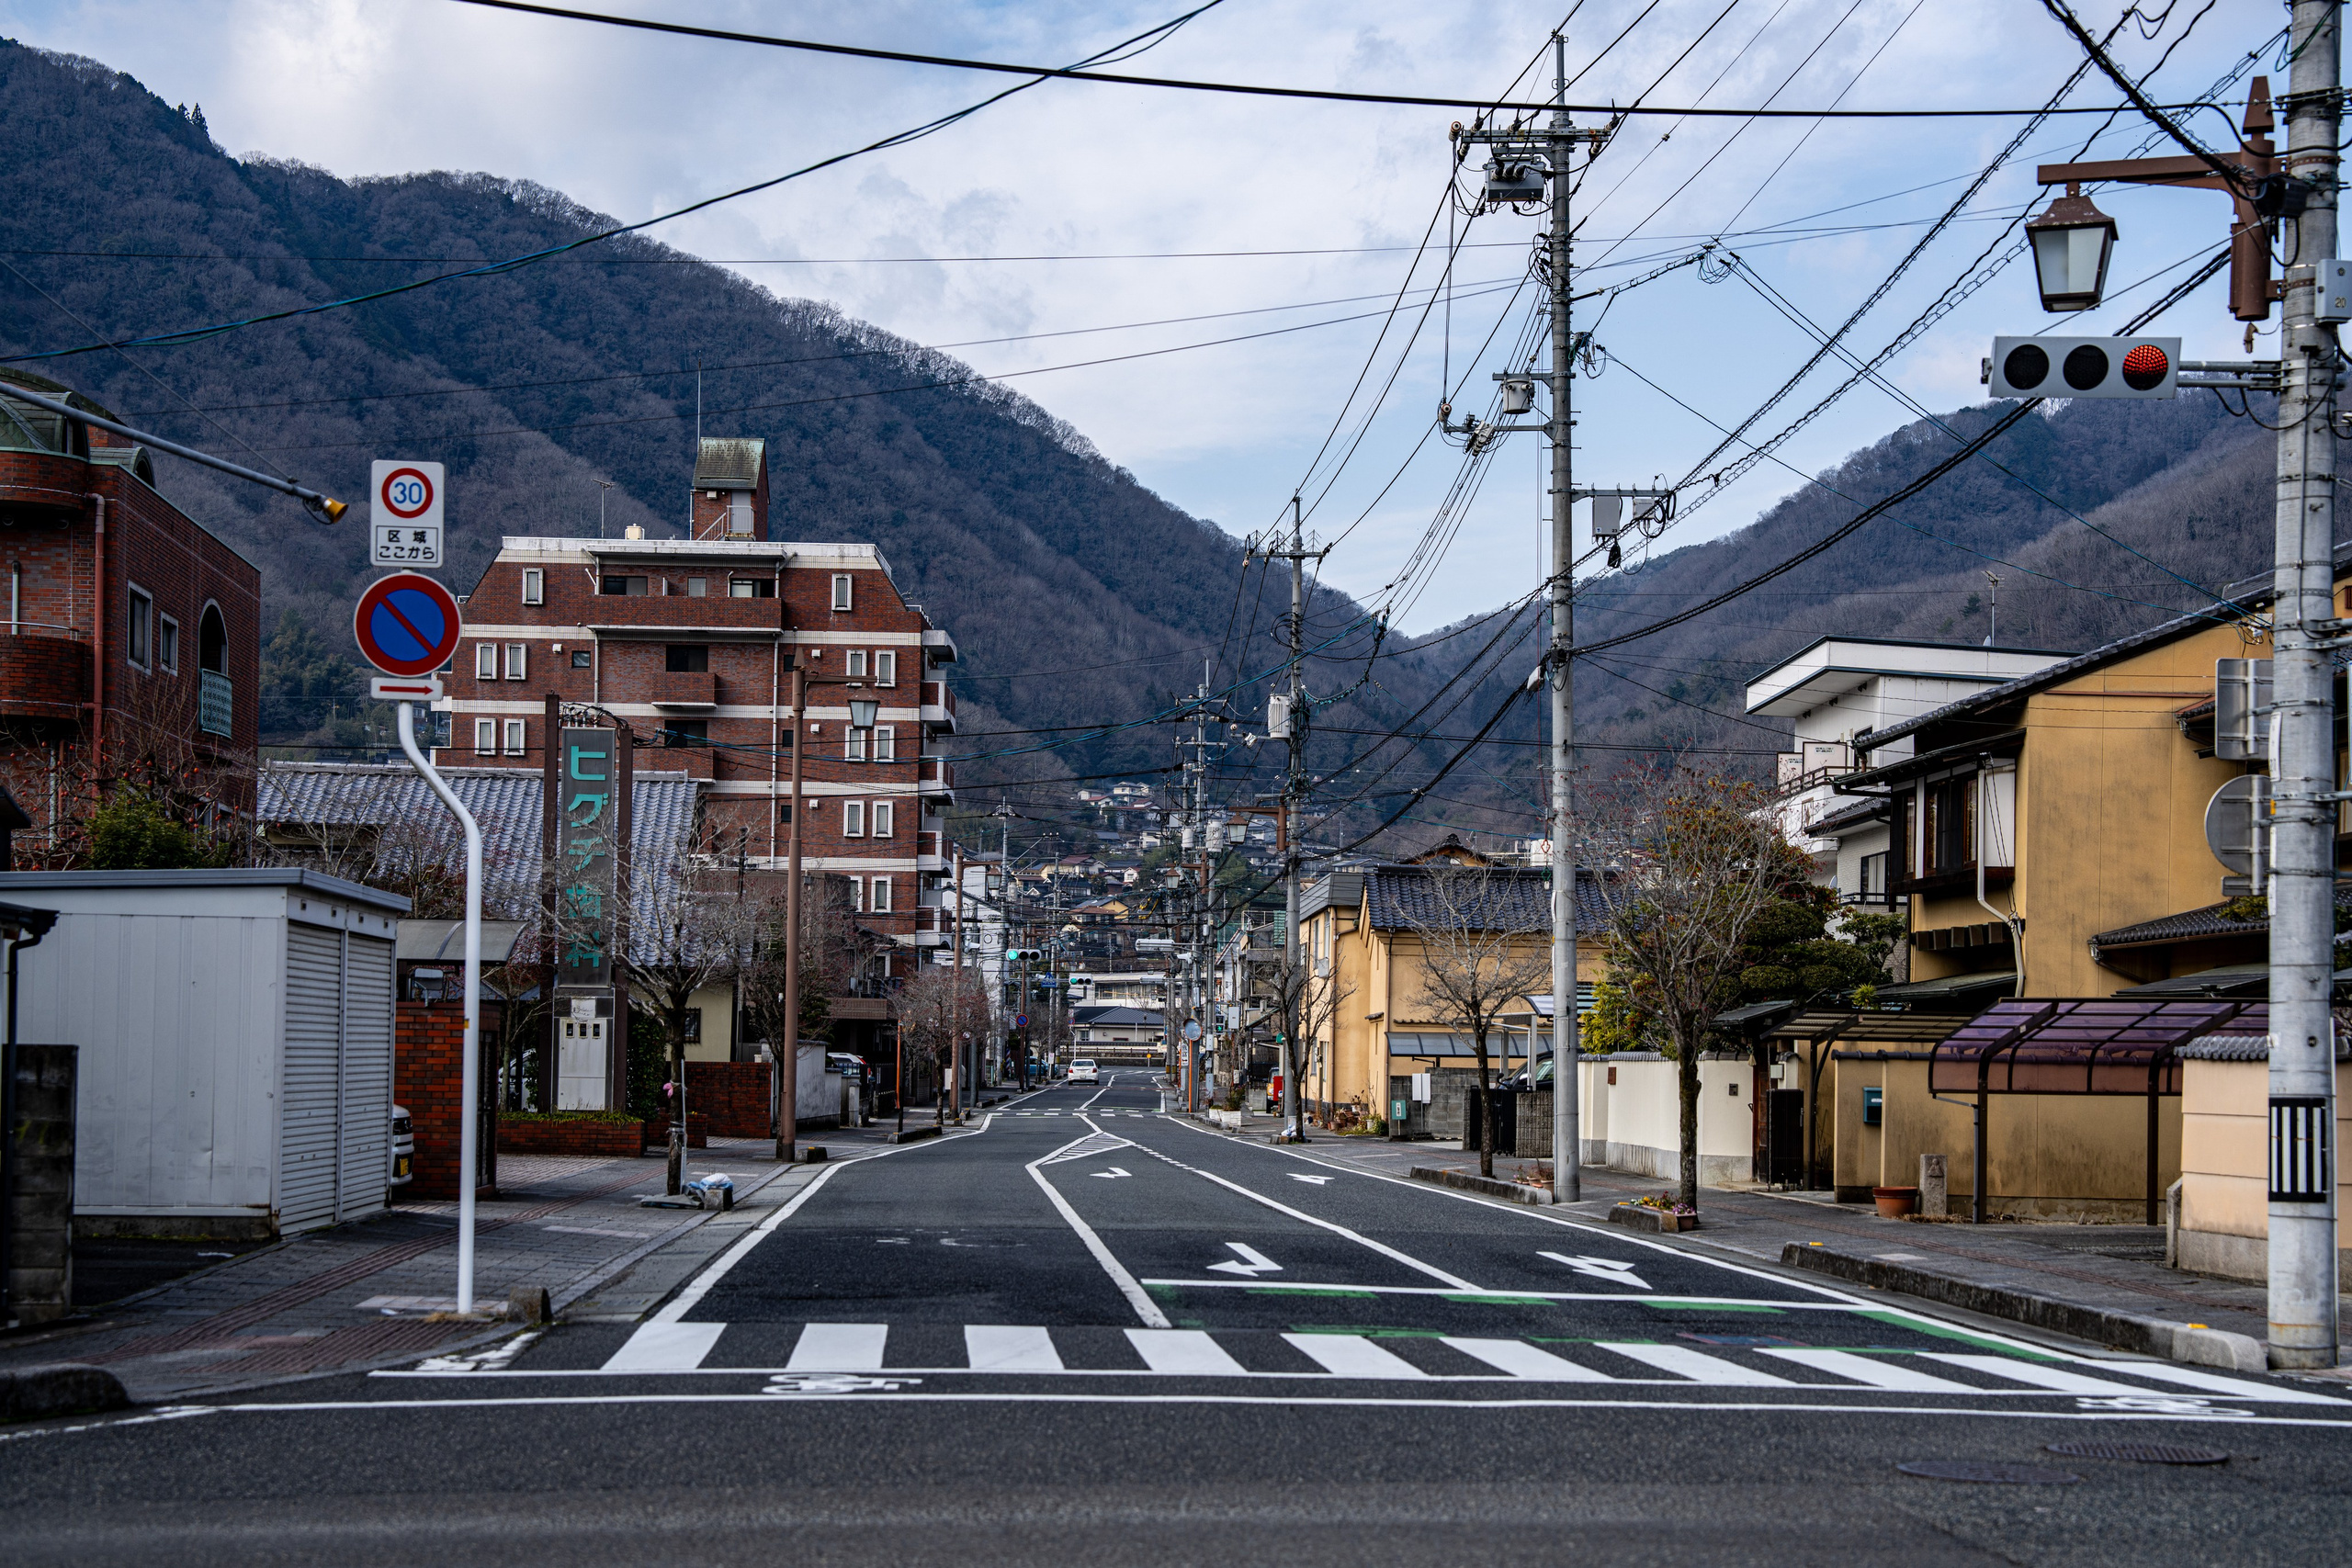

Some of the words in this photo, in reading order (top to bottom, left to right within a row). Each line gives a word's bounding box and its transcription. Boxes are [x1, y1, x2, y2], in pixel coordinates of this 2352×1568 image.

[393, 481, 423, 505] 30
[388, 530, 427, 544] 区域
[379, 546, 435, 560] ここから
